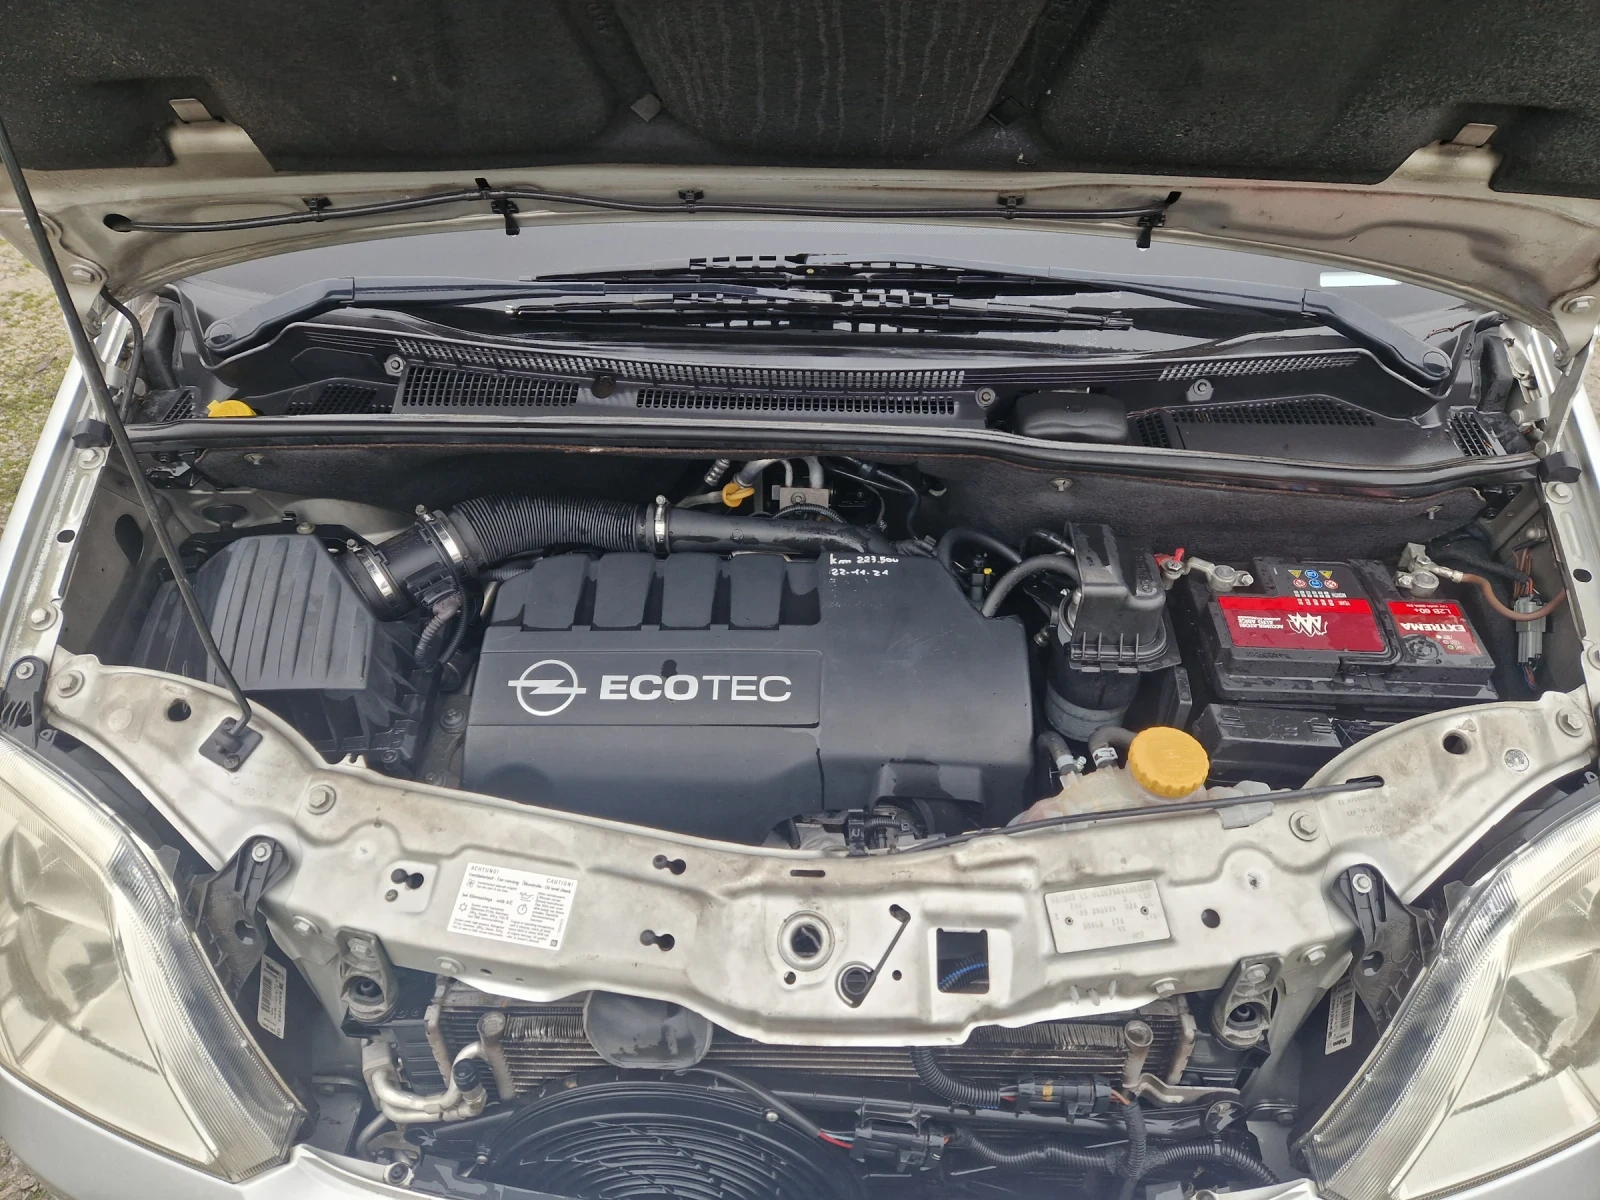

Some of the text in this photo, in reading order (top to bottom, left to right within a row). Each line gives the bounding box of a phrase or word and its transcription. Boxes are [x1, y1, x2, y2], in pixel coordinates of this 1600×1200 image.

[830, 553, 852, 564] km
[1400, 623, 1466, 632] EXTREMA
[600, 674, 792, 702] ECOTEC
[471, 866, 499, 874] ACHTUNG!
[546, 878, 574, 887] CAUTION!
